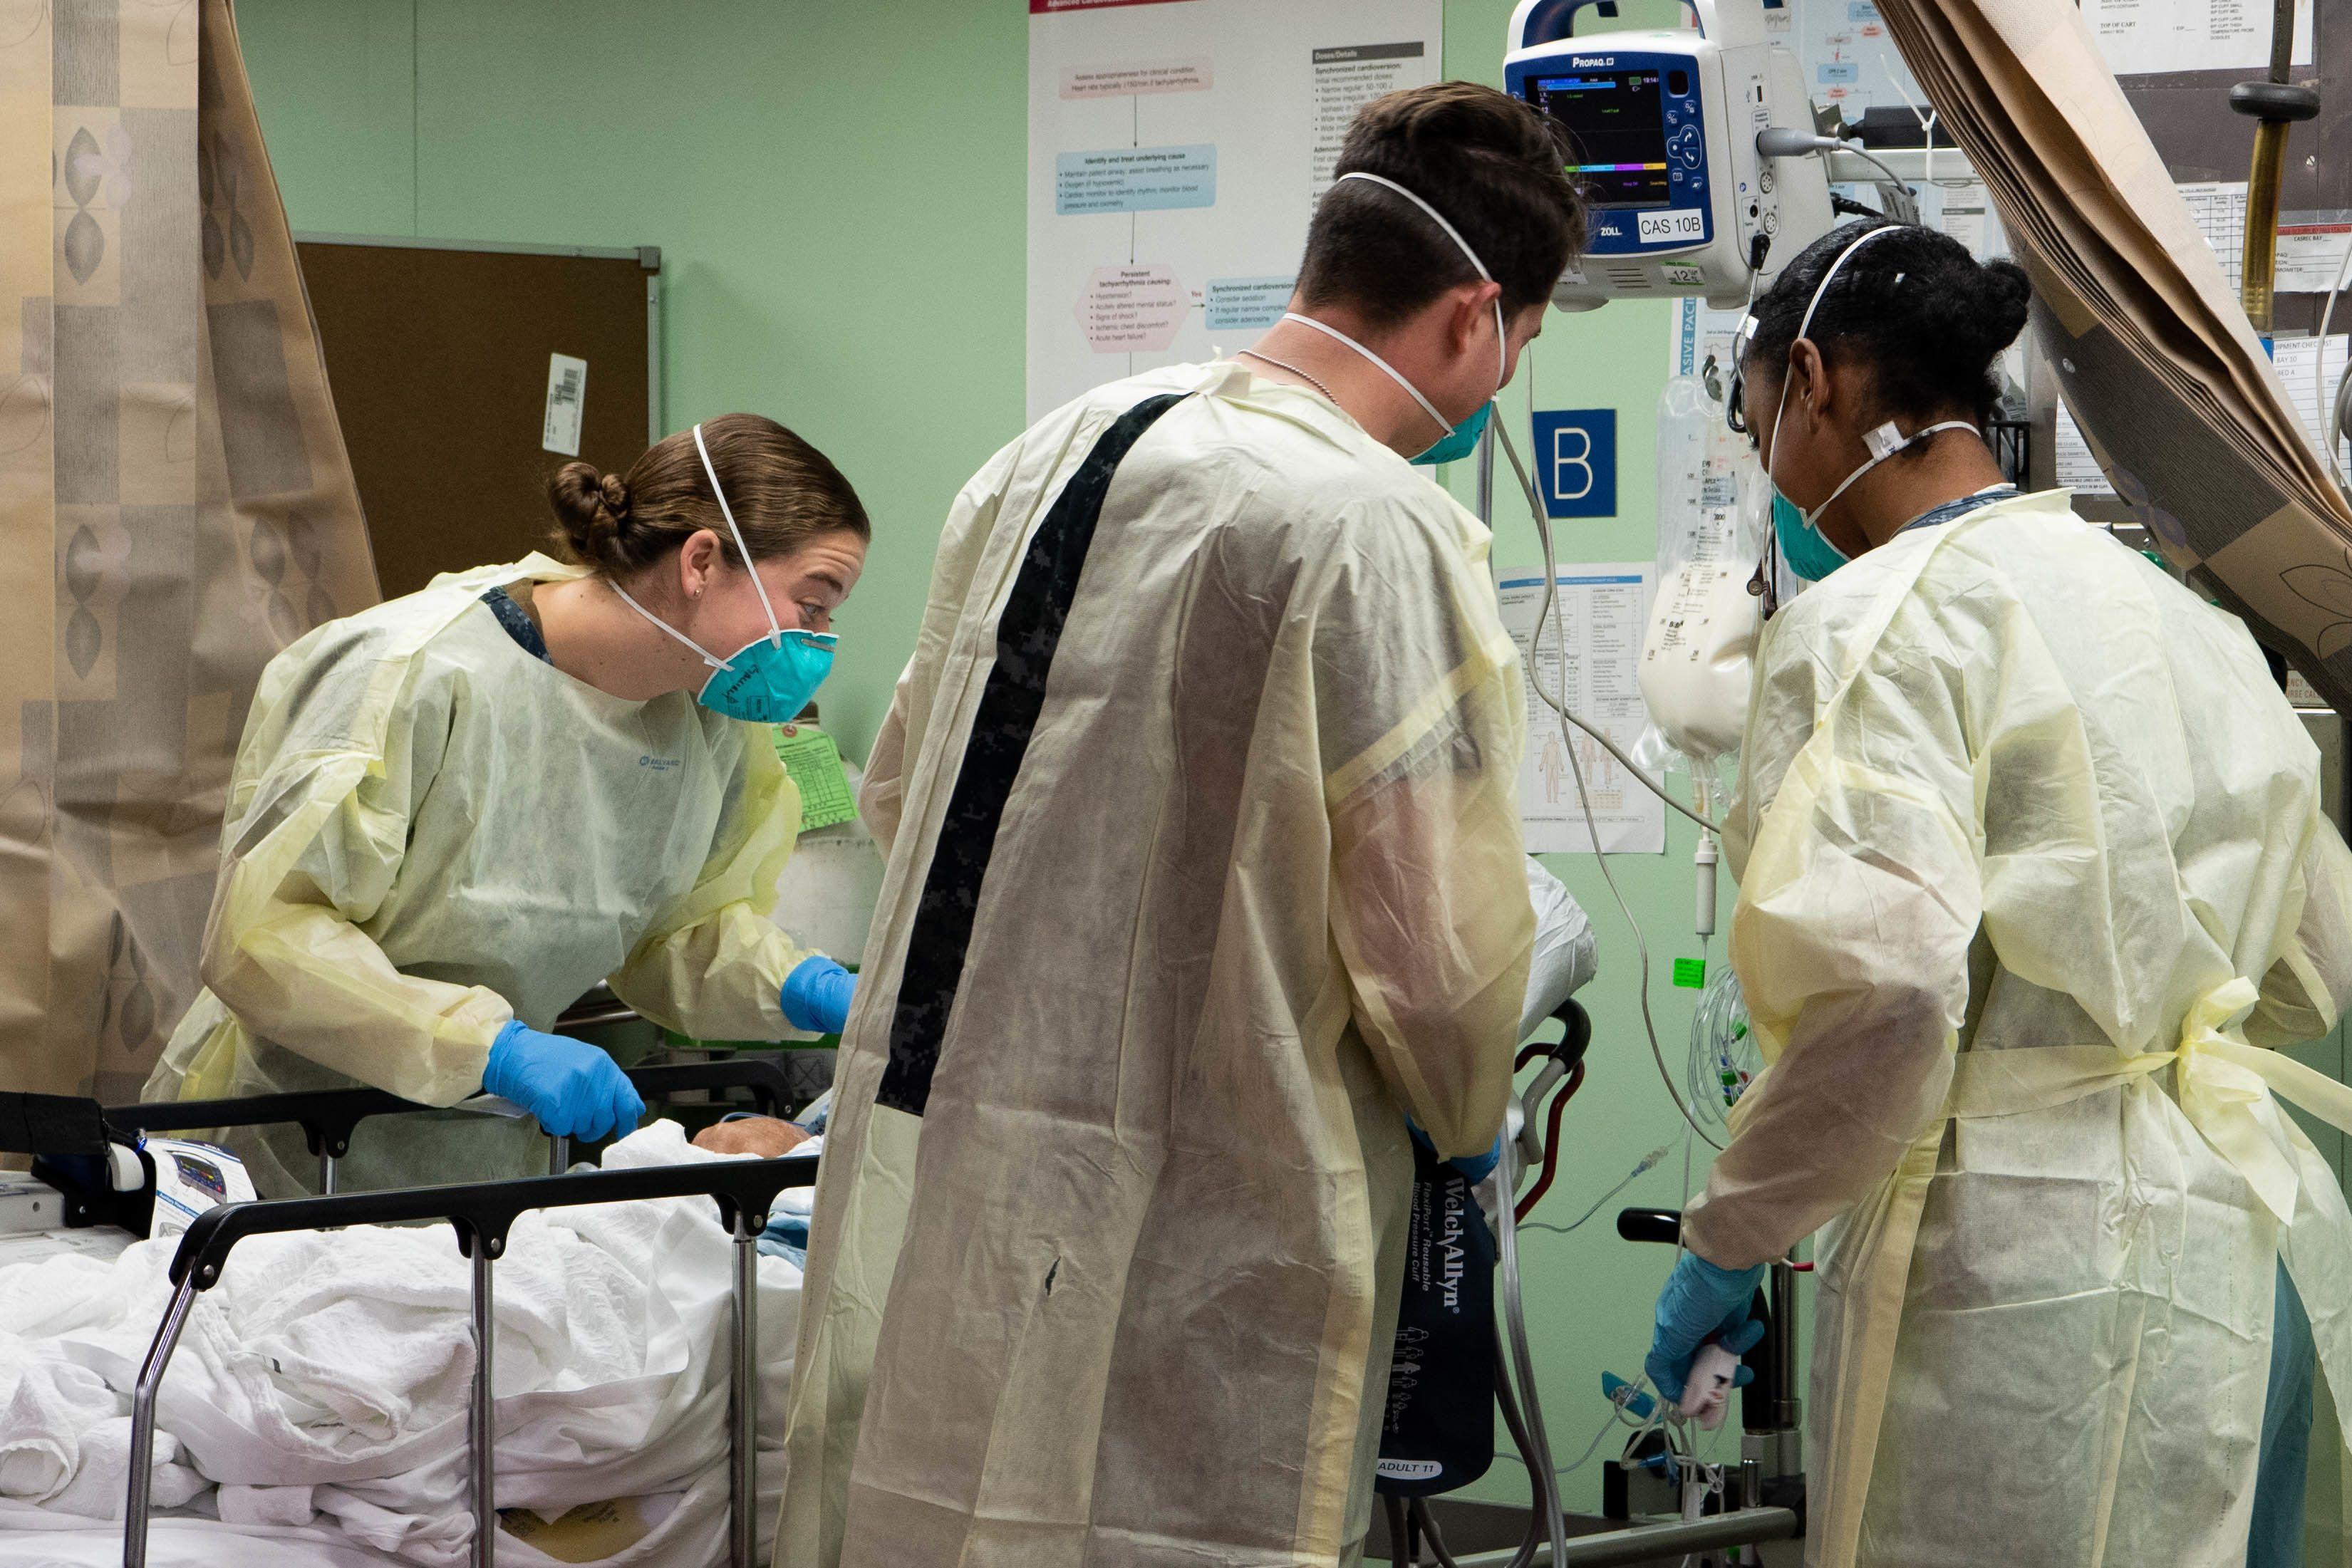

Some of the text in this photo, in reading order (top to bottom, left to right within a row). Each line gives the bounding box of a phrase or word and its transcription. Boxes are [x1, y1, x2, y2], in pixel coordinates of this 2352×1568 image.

[1573, 57, 1603, 68] PROPAQ
[1315, 63, 1402, 75] Synchronized cardioversion:
[1331, 74, 1373, 83] recommended
[1136, 153, 1167, 163] underlying
[1146, 165, 1172, 175] breathing
[1181, 165, 1209, 173] necessary
[1064, 181, 1085, 189] Oxygen
[1641, 217, 1701, 235] CAS 10B
[1600, 227, 1622, 237] ZOLL
[1212, 285, 1252, 294] Synchronized
[1215, 295, 1241, 303] Consider
[1220, 306, 1240, 315] regular
[1555, 427, 1592, 499] B
[1422, 1238, 1431, 1292] Reusable
[1411, 1260, 1420, 1282] Cuff
[1378, 1461, 1434, 1473] ADULT 11
